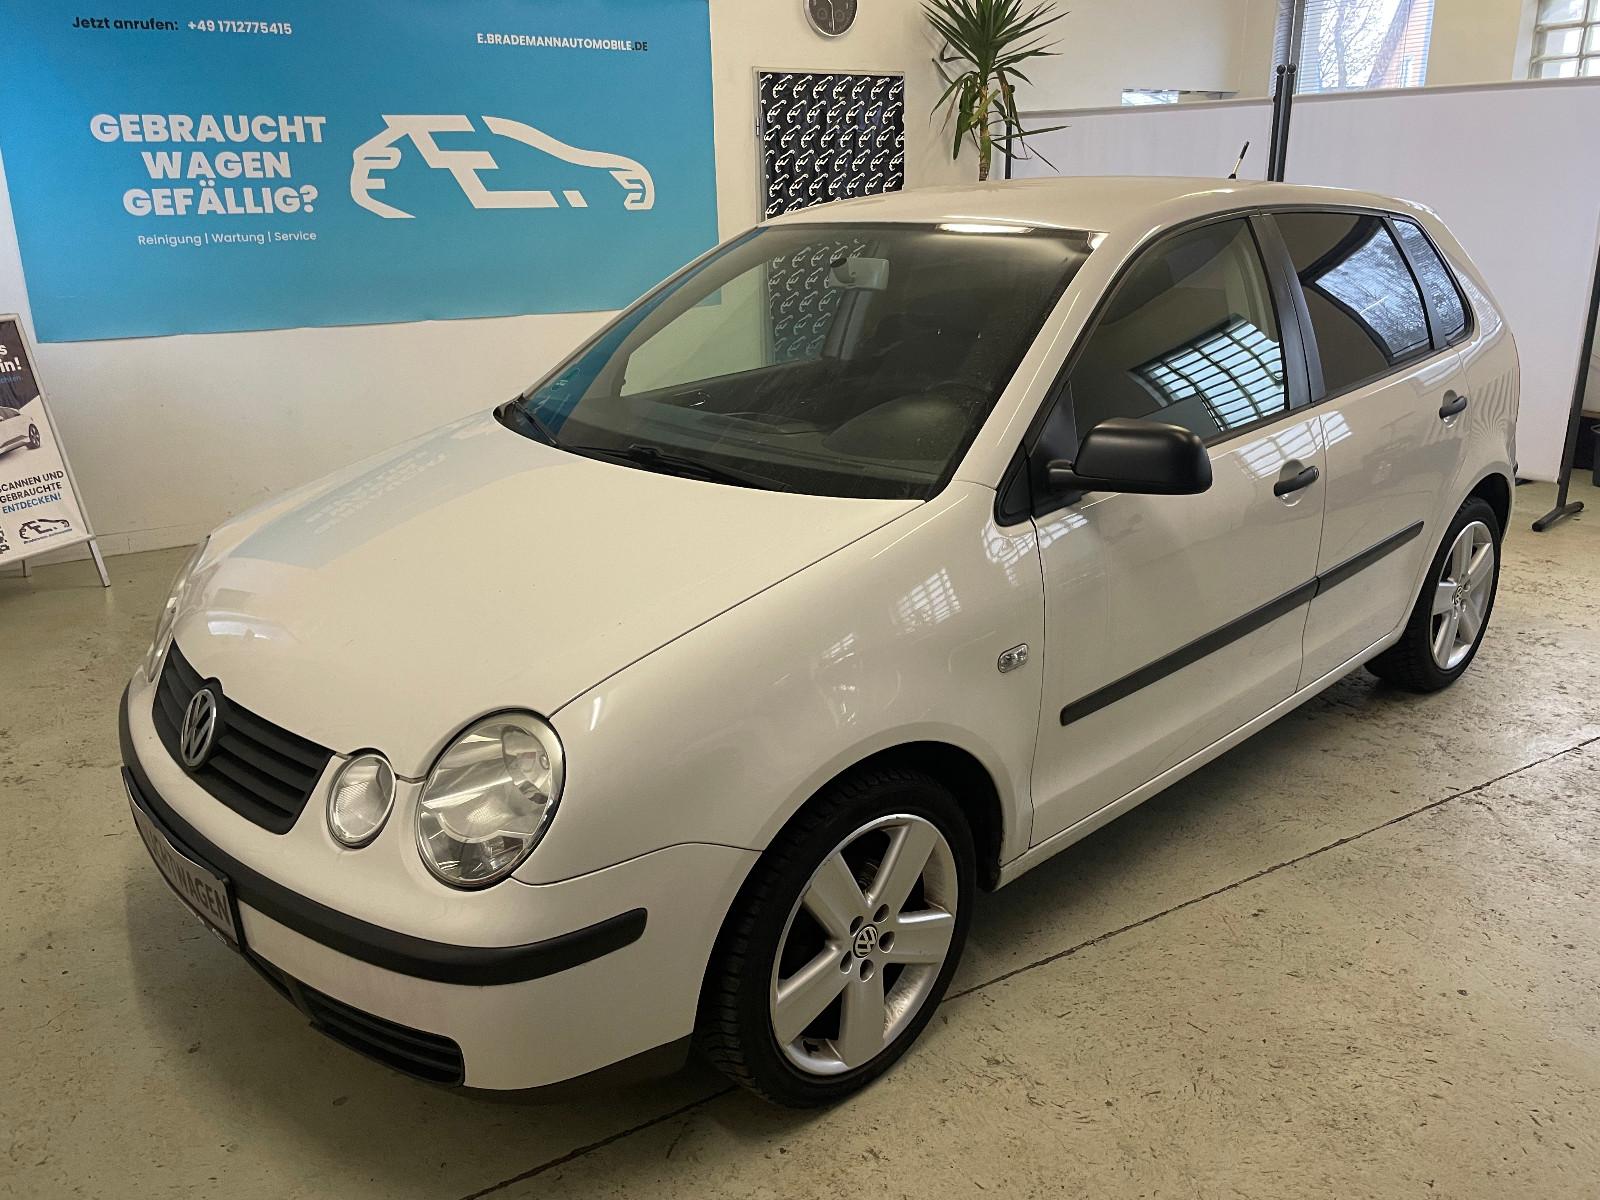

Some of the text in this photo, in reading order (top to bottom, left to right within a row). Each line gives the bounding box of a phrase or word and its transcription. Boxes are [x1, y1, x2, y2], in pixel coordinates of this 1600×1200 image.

[72, 16, 293, 35] Jetzt anrufen: +49 1712775415
[476, 32, 649, 52] E.BRADEMANNAUTOMOBILE.DE
[89, 113, 327, 144] GEBRAUCHT
[140, 151, 292, 180] WAGEN
[122, 179, 319, 217] GEFÄLLIG?
[137, 232, 202, 247] Reinigung
[211, 231, 265, 245] Wartung
[274, 230, 317, 242] Service
[42, 470, 64, 482] UND
[0, 481, 63, 504] GEBRAUCHTE
[2, 491, 62, 514] ENTDECKEN!
